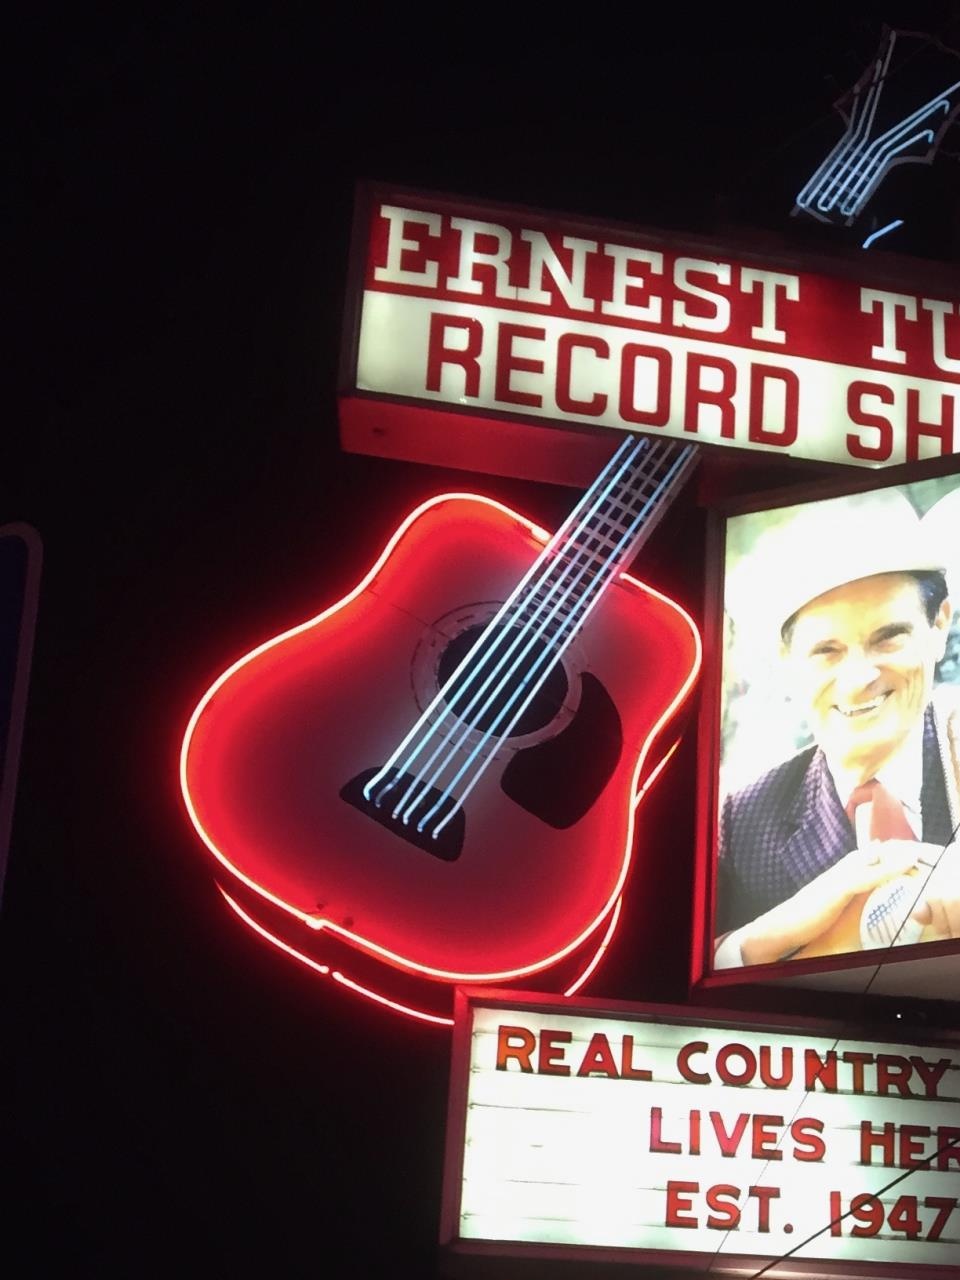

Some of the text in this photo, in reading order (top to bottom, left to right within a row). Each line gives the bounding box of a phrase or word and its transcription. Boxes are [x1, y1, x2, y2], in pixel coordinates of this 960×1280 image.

[373, 204, 800, 345] ERNEST
[425, 312, 800, 448] RECORD
[495, 1025, 653, 1082] REAL
[676, 1040, 952, 1100] COUNTRY
[649, 1106, 826, 1162] LIVES
[664, 1180, 958, 1243] EST. 1947
